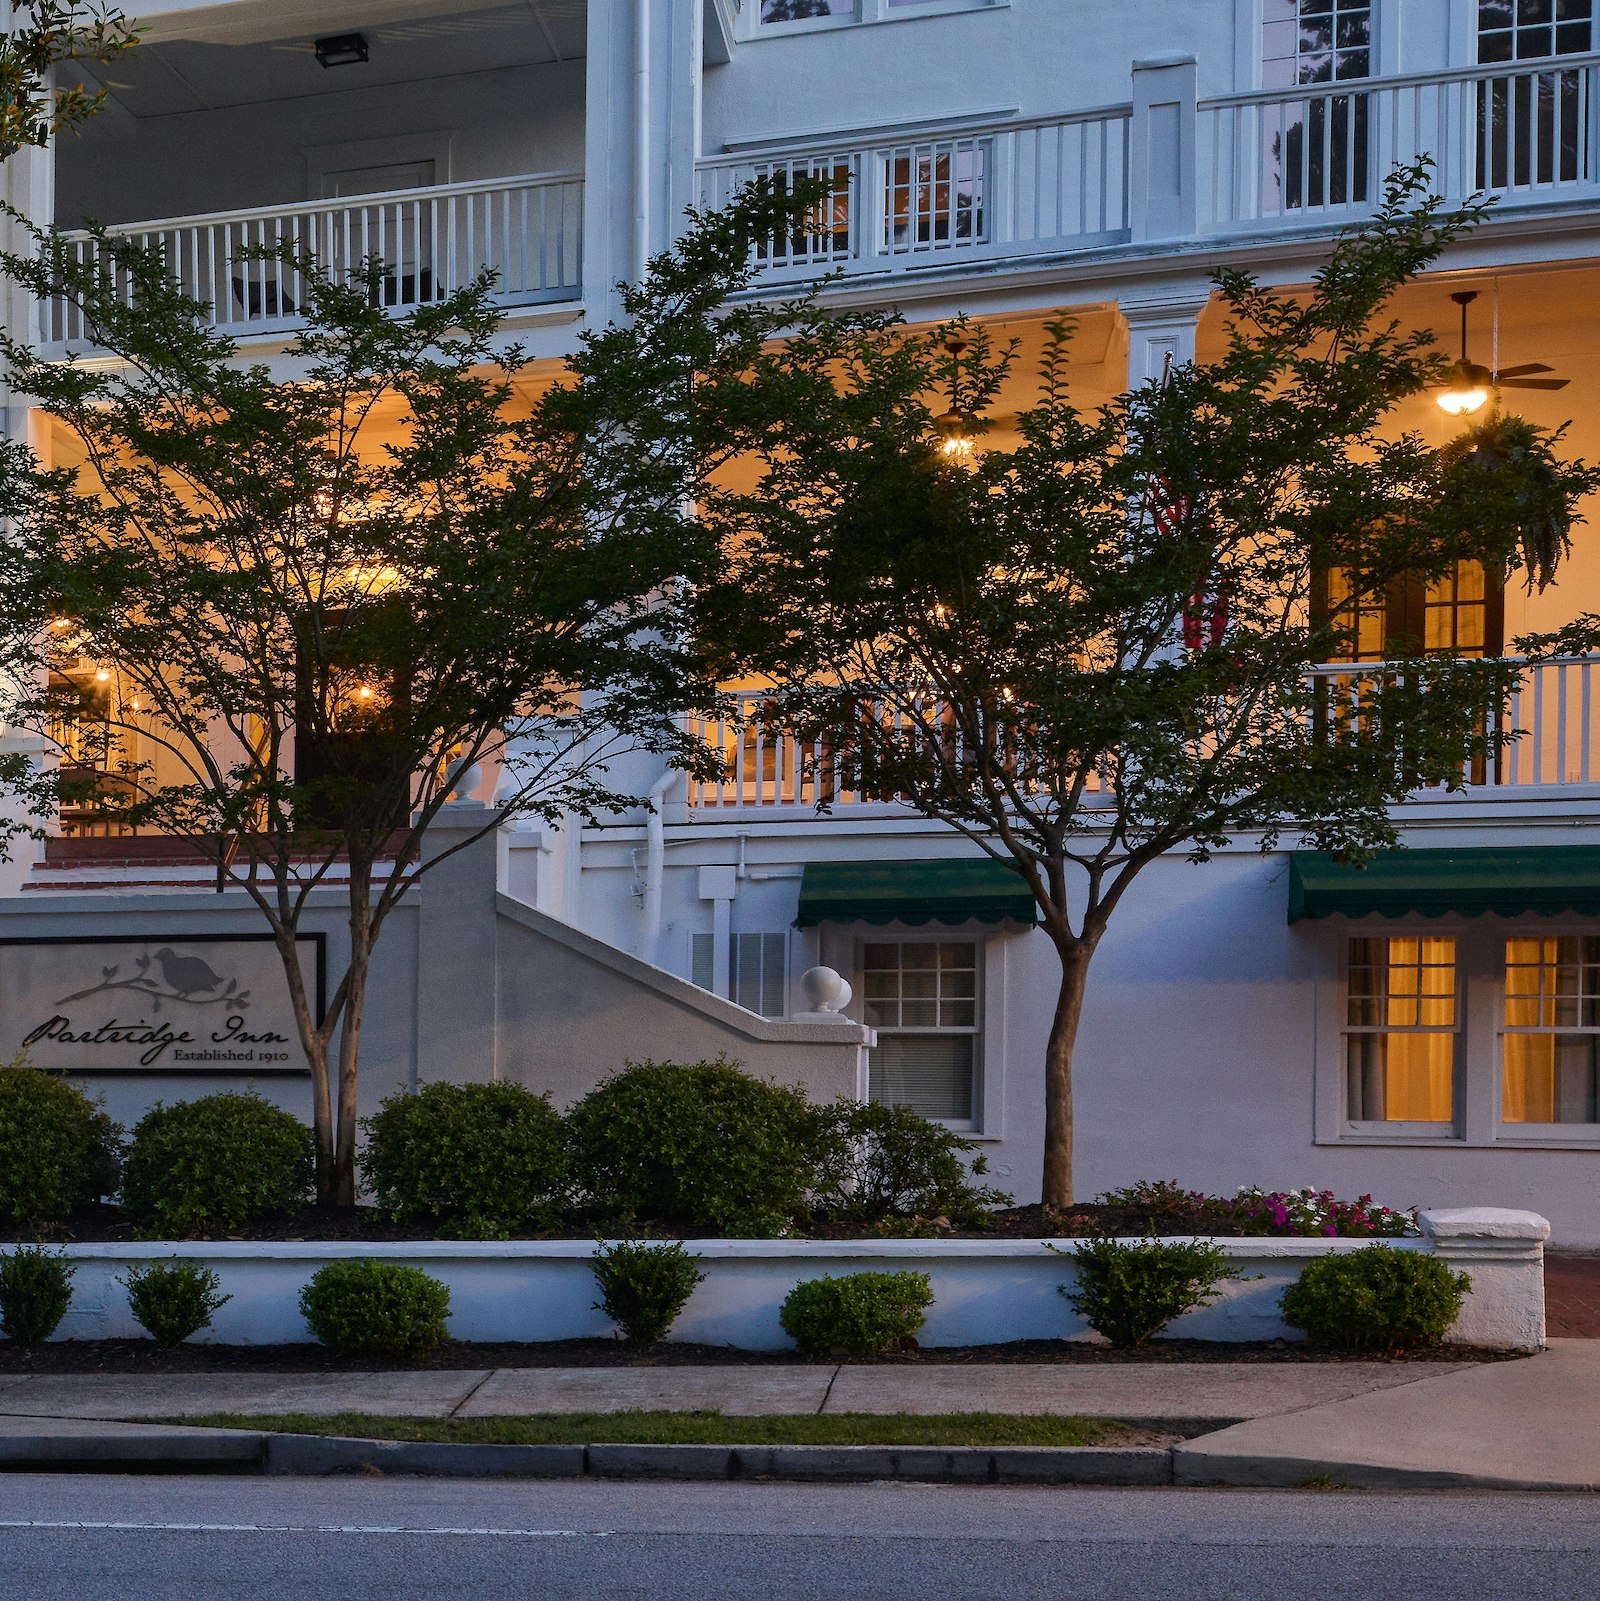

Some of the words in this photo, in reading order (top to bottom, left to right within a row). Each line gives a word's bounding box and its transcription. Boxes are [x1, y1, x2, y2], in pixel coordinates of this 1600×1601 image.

[22, 1015, 195, 1066] Partridge
[211, 1015, 289, 1044] Inn
[173, 1048, 254, 1062] Established
[257, 1051, 290, 1064] 1910
